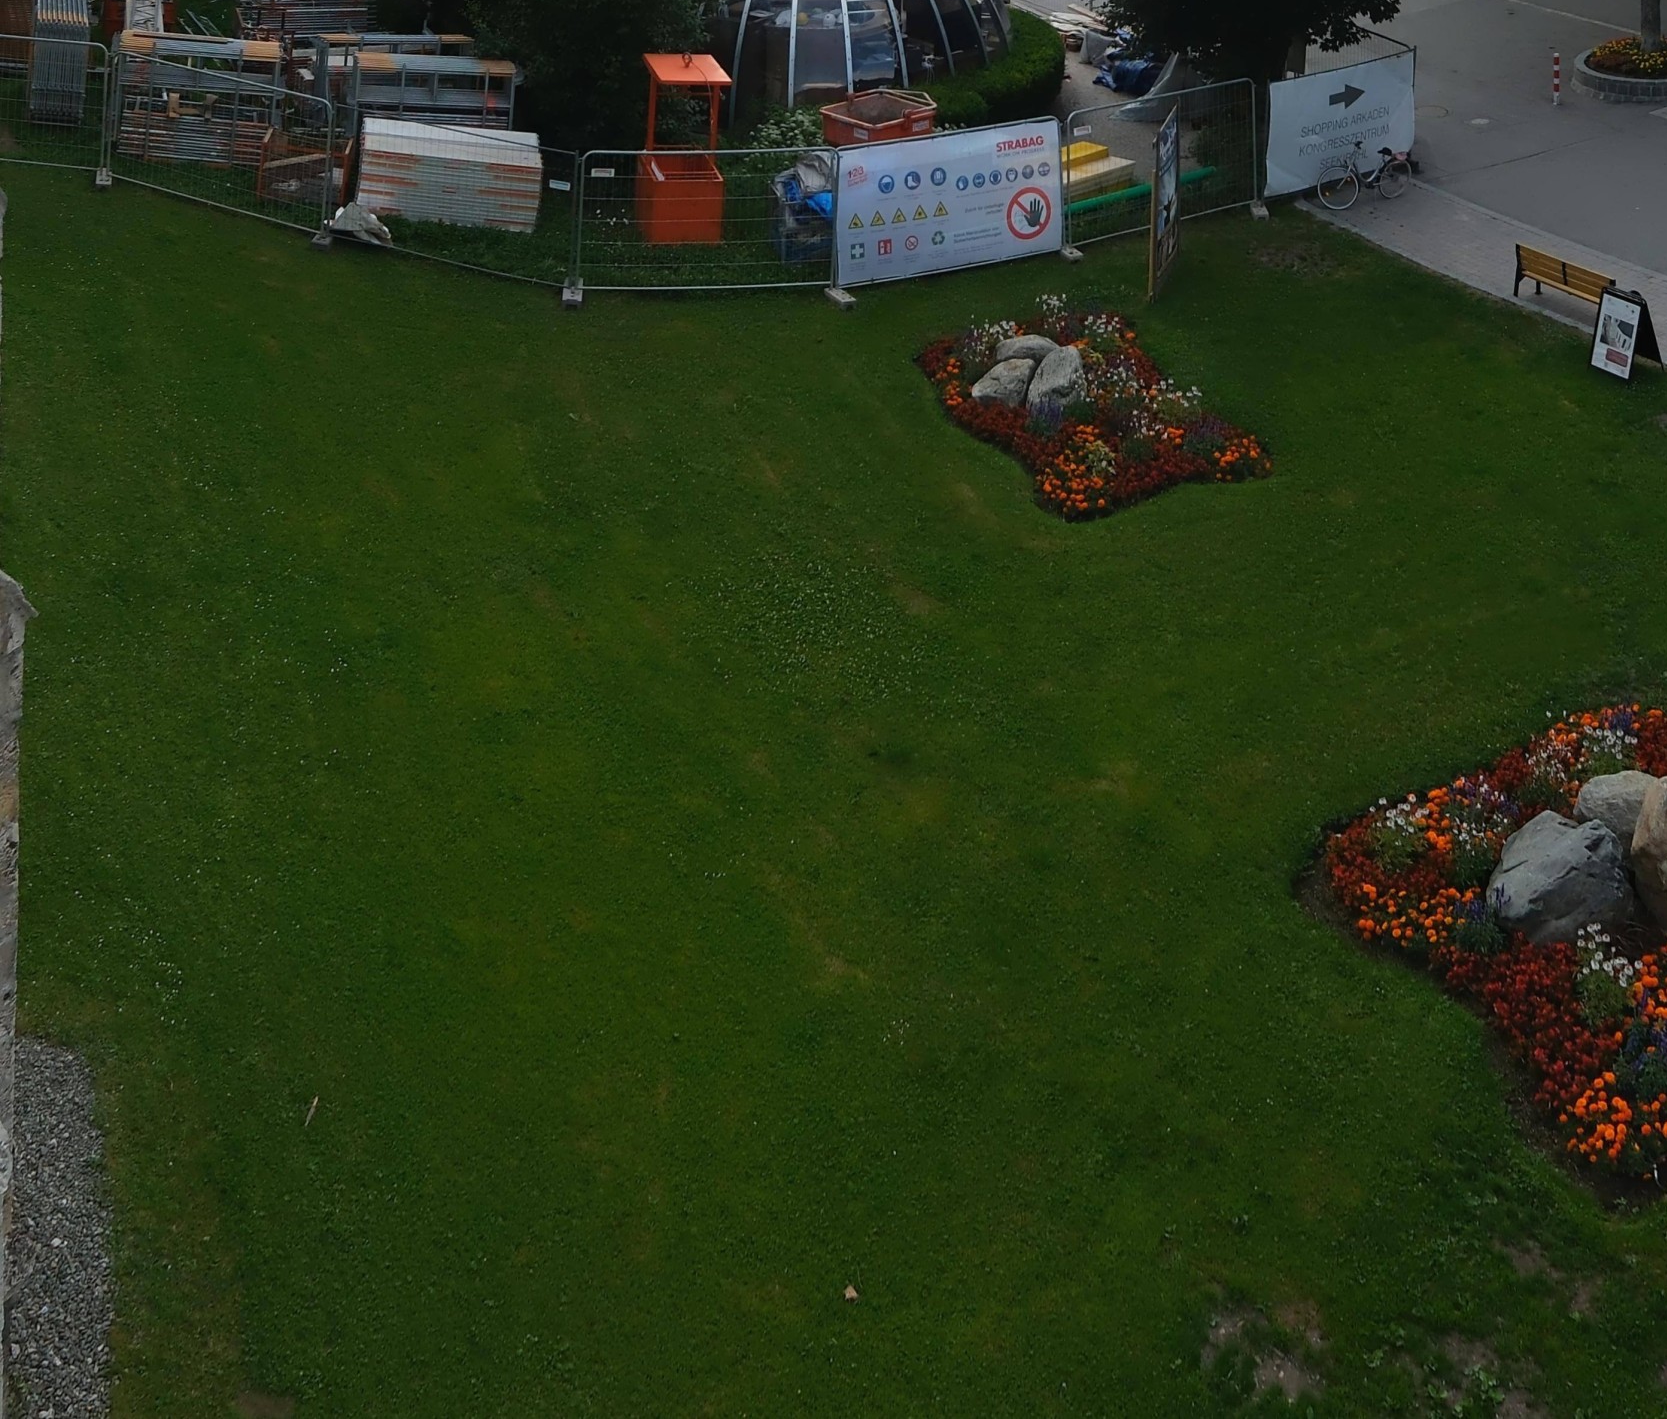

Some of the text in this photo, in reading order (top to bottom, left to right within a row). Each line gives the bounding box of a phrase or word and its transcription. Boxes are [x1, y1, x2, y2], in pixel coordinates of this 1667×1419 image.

[1301, 107, 1389, 138] SHOPPING ARKADEN
[996, 135, 1044, 152] STRABAG
[1299, 125, 1389, 156] KONGRESSZENTRUM
